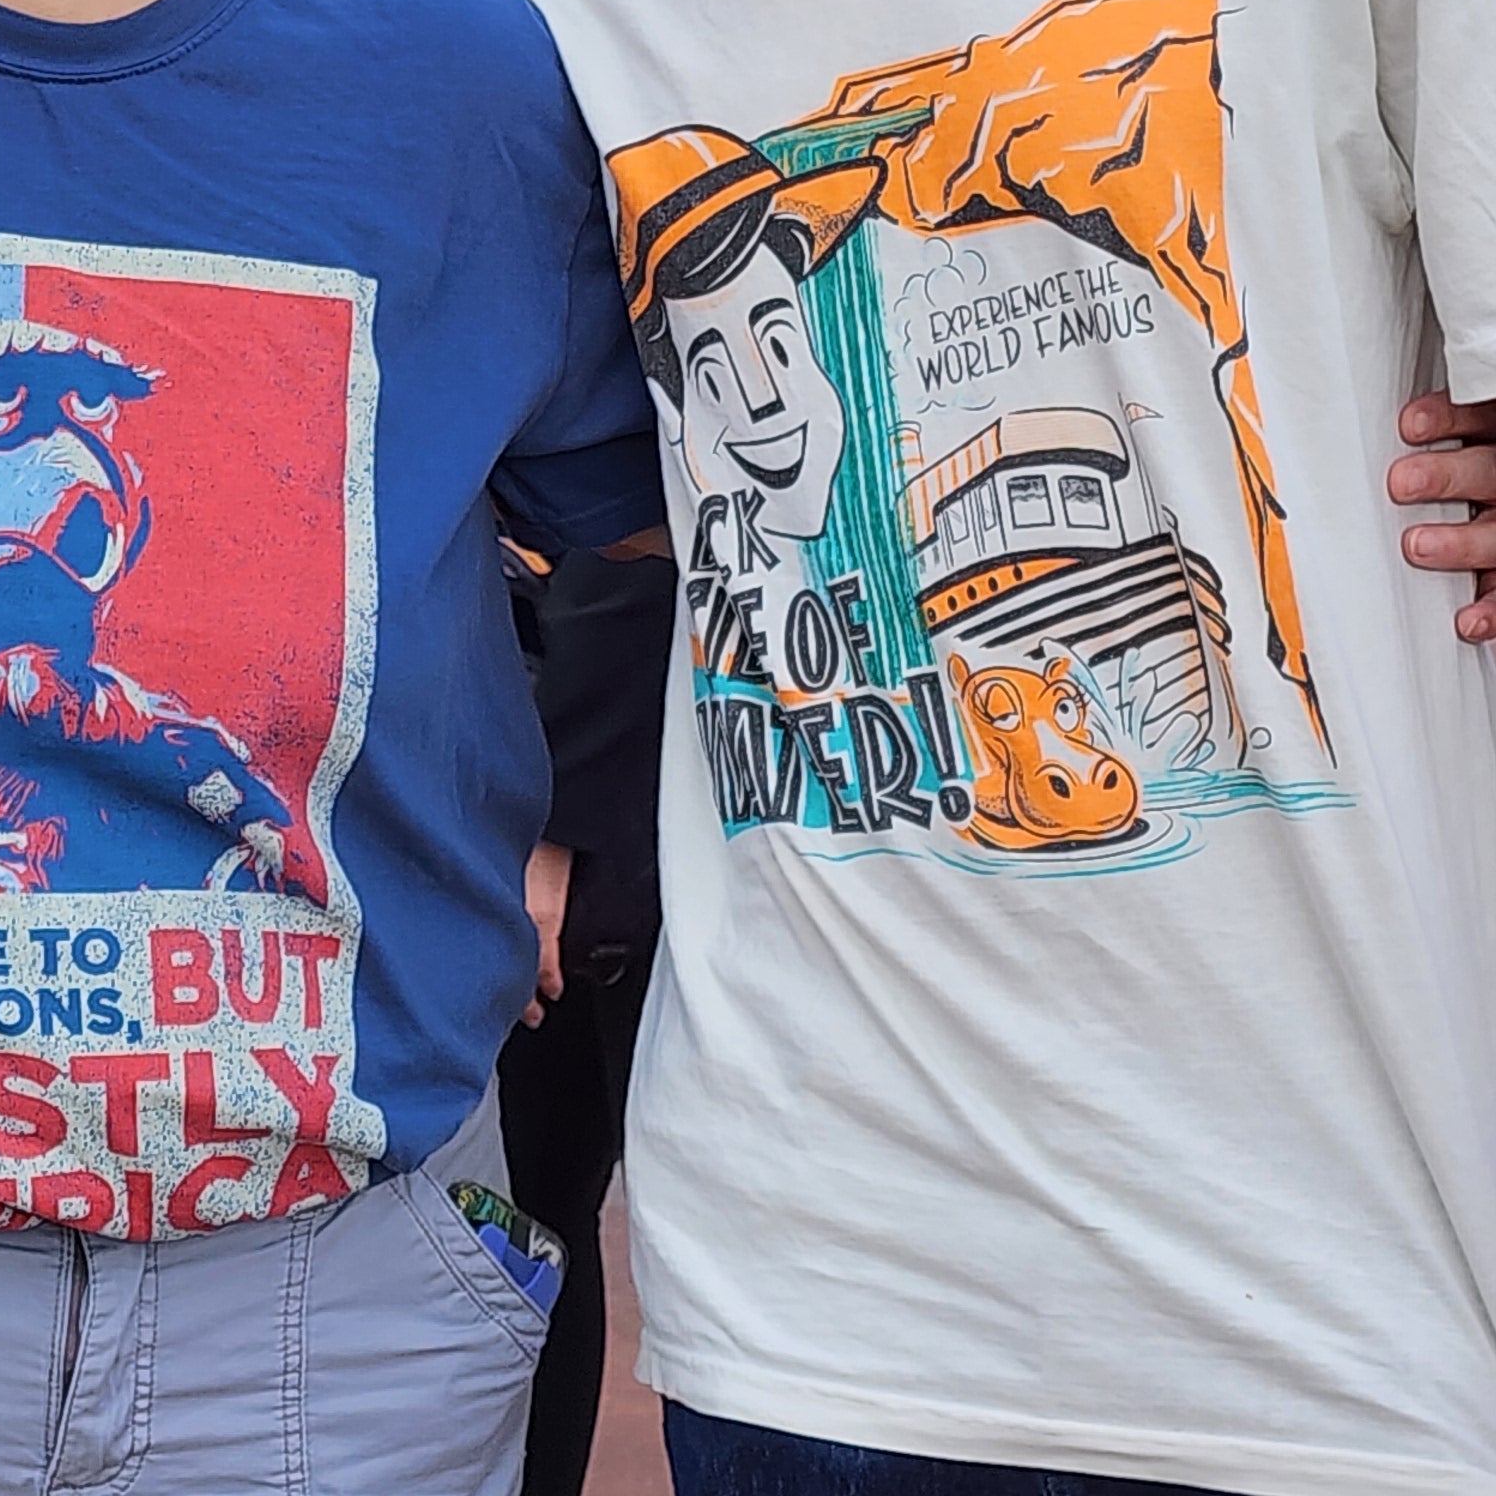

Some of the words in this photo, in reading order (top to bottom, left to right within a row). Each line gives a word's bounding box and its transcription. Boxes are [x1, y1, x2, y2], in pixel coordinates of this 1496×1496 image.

[916, 326, 1021, 393] WORLD
[1033, 293, 1155, 359] FAMOUS
[928, 271, 1075, 344] EXPERIENCE
[1074, 260, 1123, 301] THE
[784, 574, 873, 694] OF
[30, 927, 123, 977] TO
[148, 928, 342, 1030] BUT
